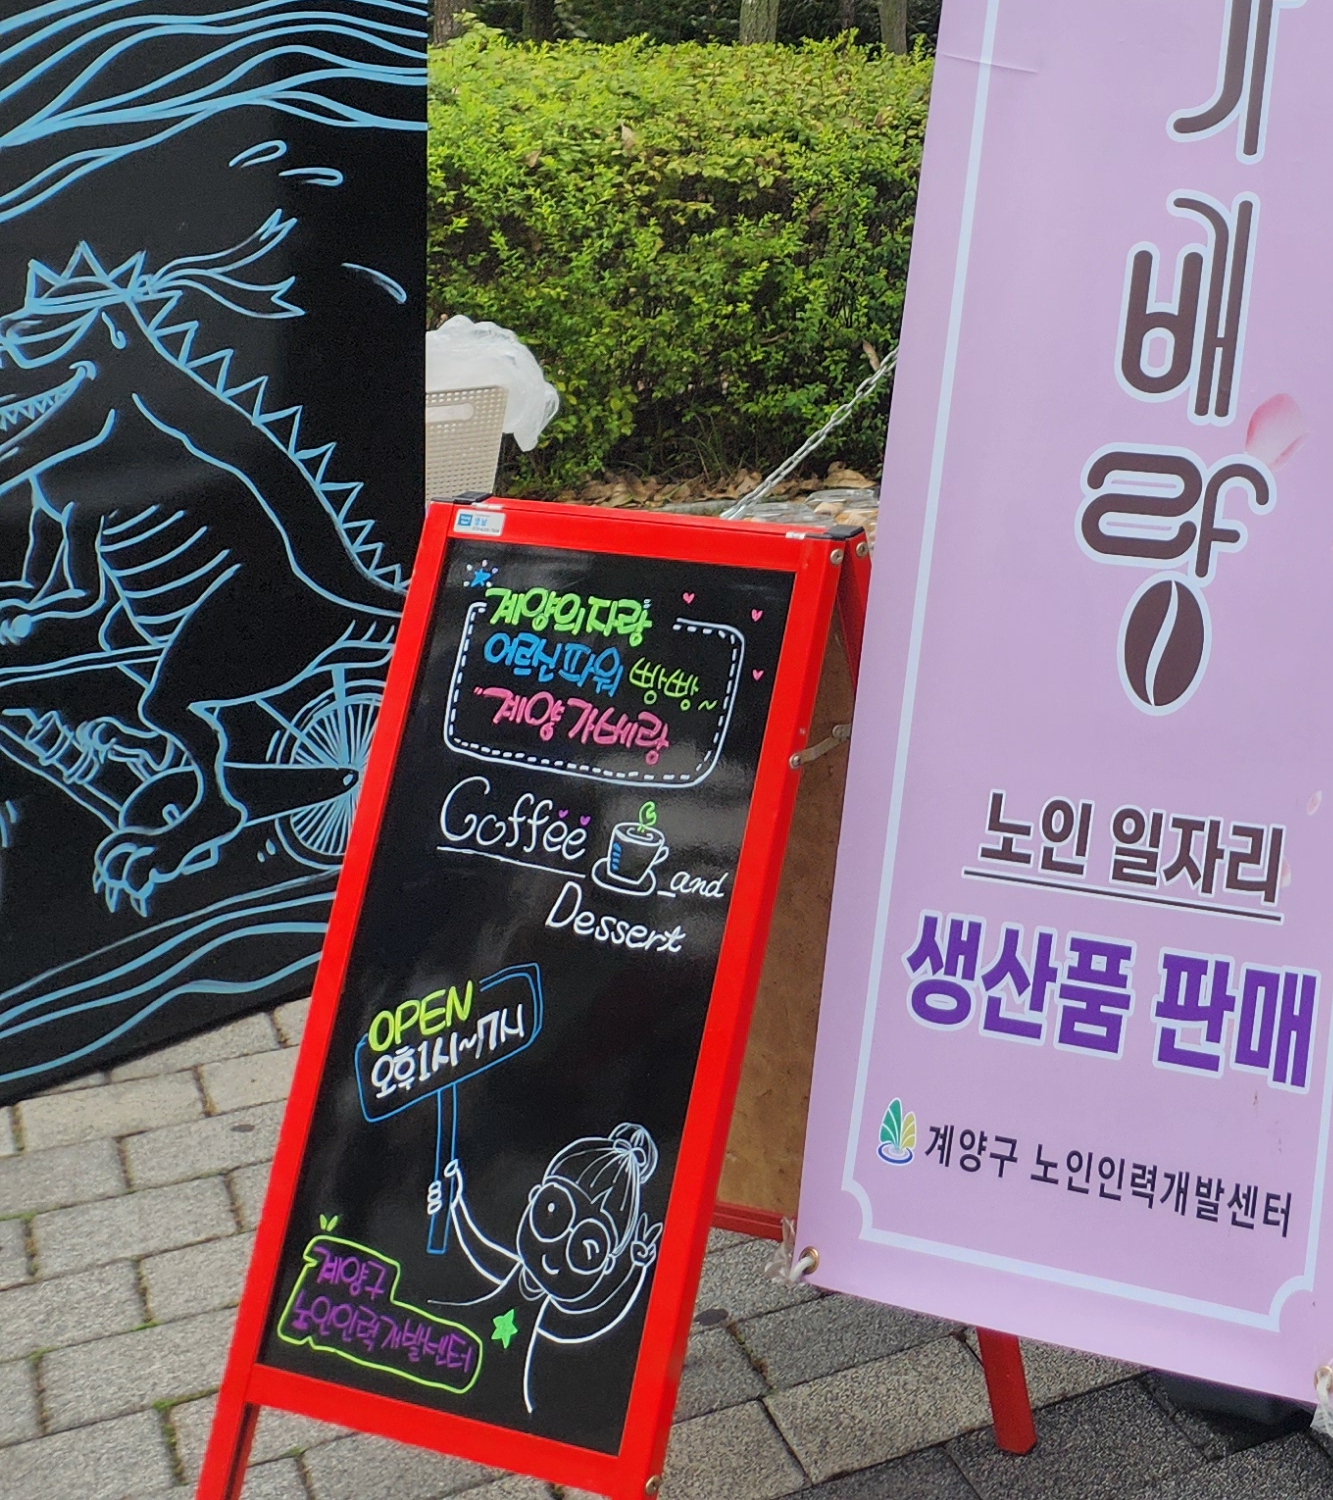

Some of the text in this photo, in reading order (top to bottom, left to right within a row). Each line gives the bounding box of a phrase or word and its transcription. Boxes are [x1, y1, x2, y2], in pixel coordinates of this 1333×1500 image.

[440, 776, 587, 860] Coffee
[976, 790, 1286, 905] 노인 일자리
[545, 881, 686, 952] Dessert
[670, 870, 729, 898] and
[368, 980, 474, 1052] OPEN
[906, 913, 1318, 1091] 생산품 판매
[925, 1124, 1293, 1238] 계양구 노인인력개발센터
[313, 1246, 388, 1300] 계양구
